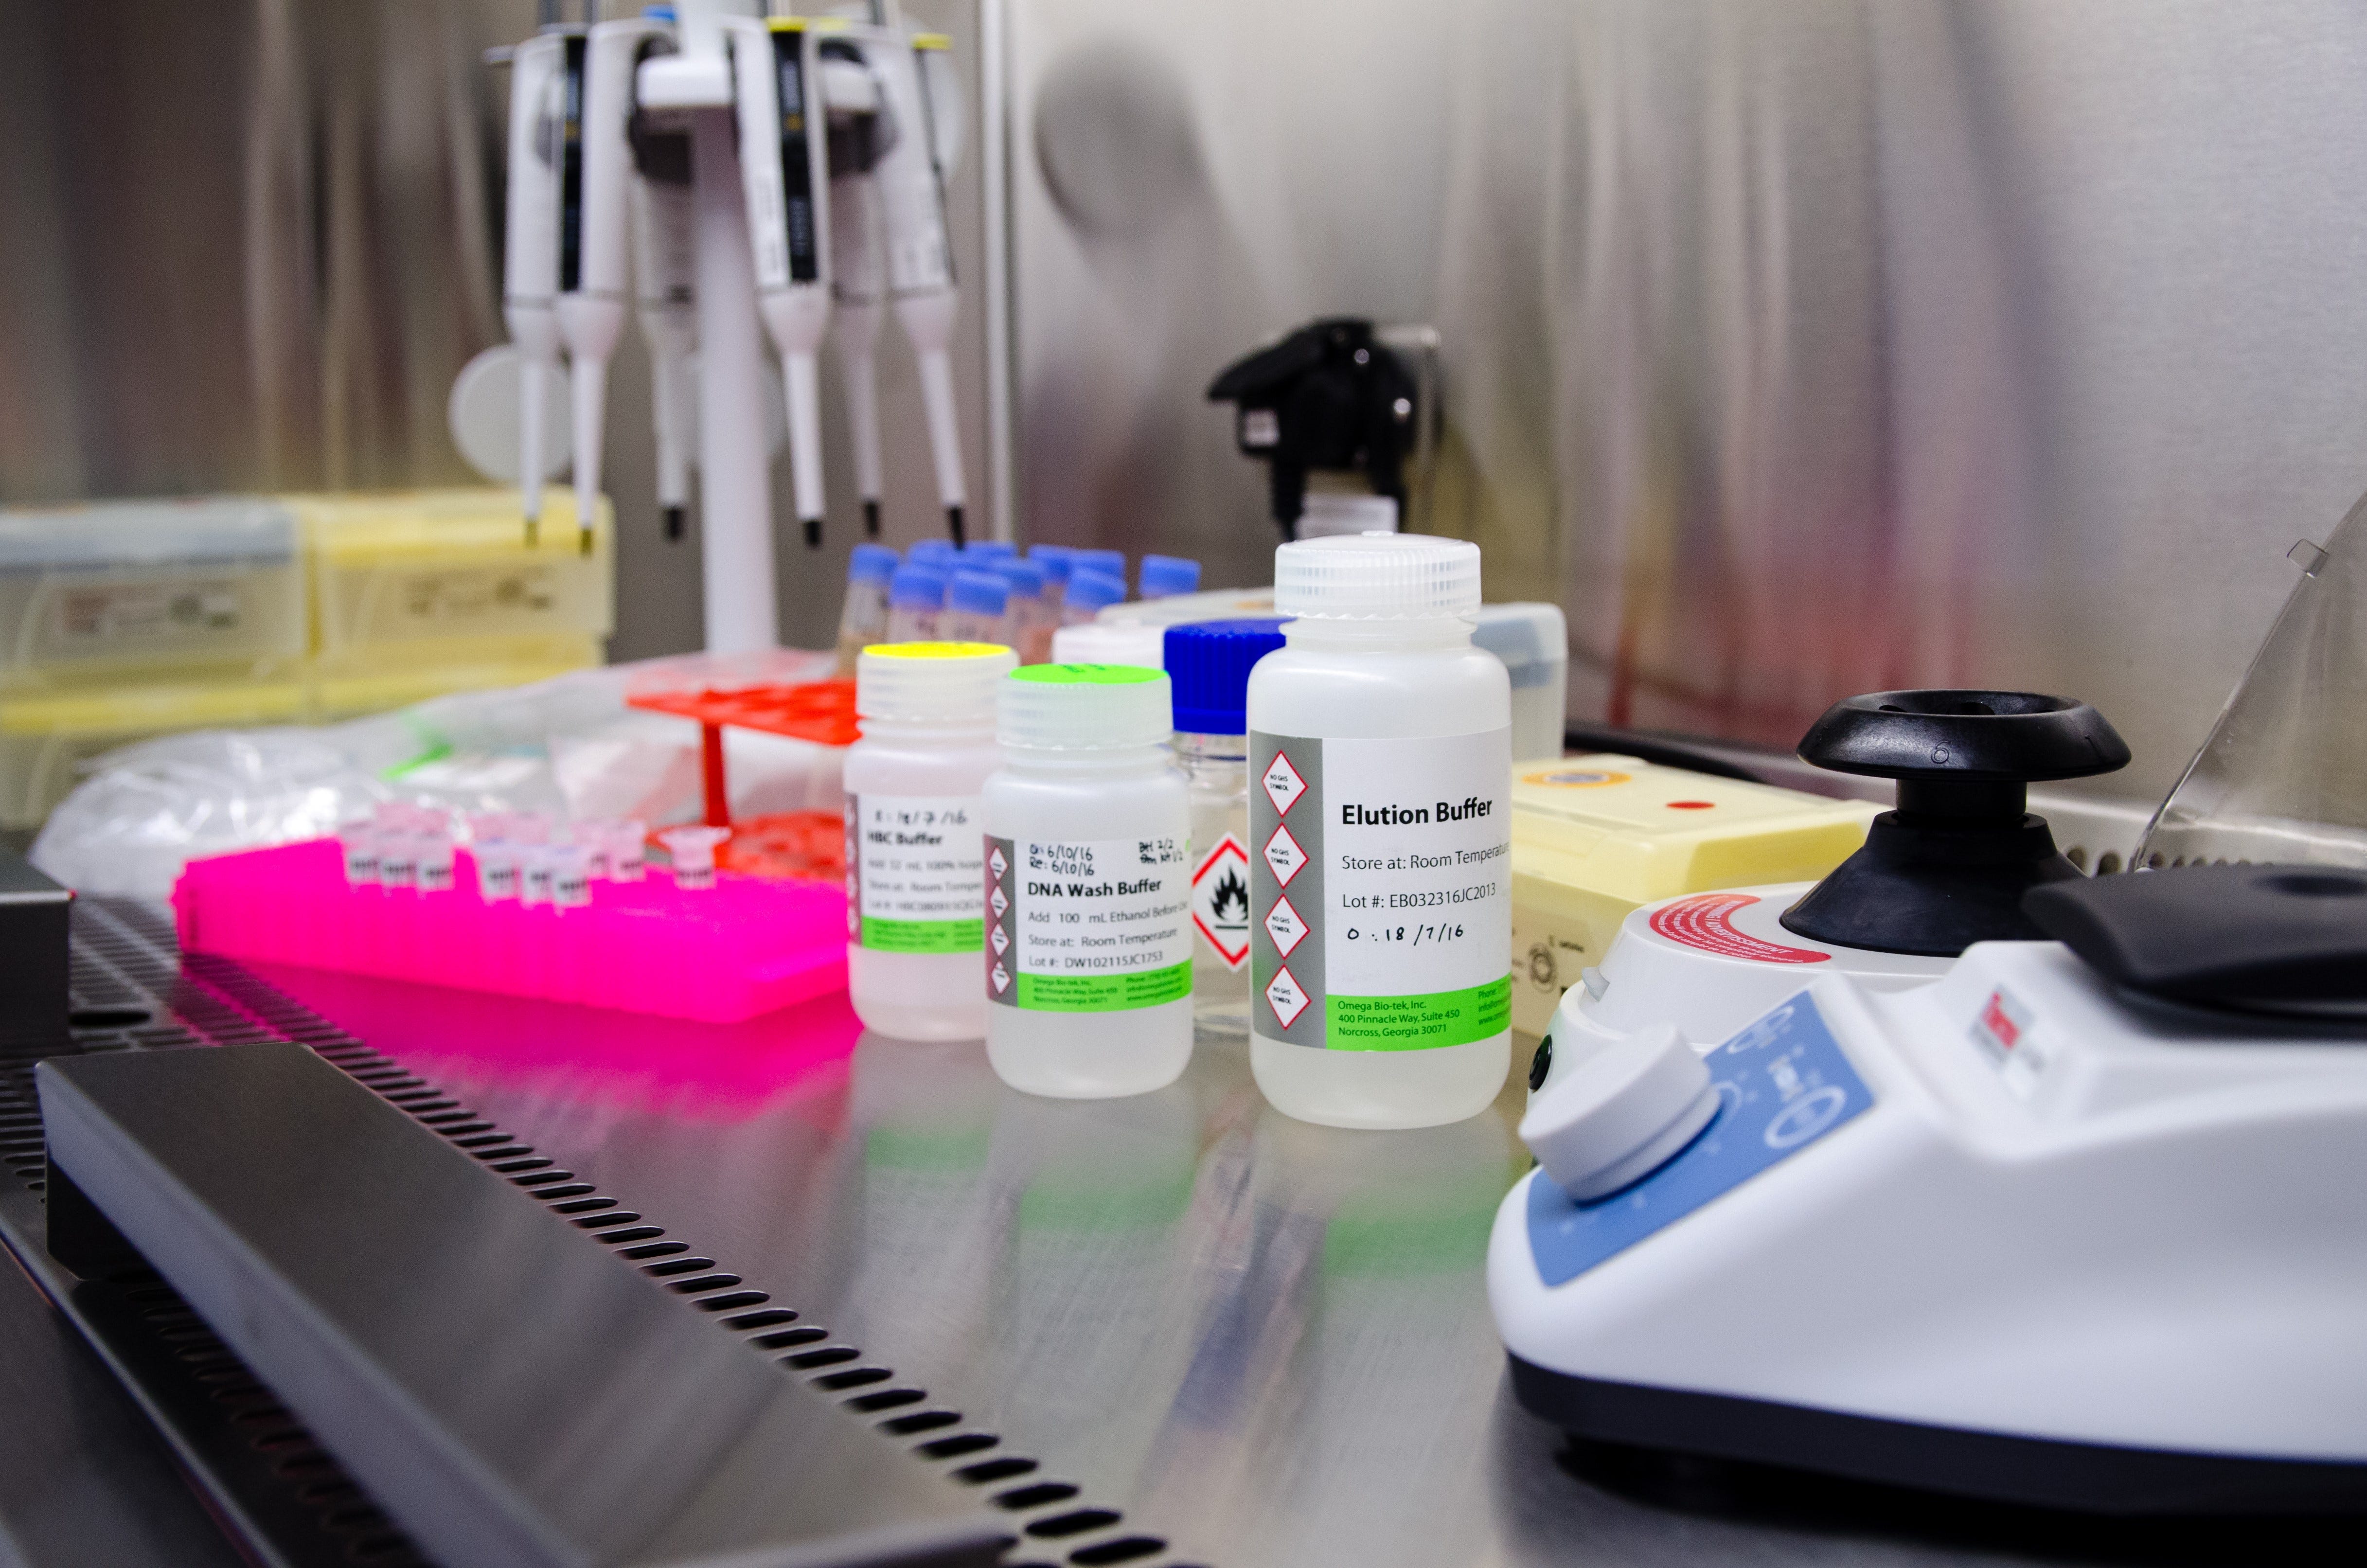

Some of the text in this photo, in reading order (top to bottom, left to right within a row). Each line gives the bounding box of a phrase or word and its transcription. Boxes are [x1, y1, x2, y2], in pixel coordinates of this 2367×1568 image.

[1342, 797, 1492, 825] Elution Buffer
[896, 831, 942, 845] Buffer
[1271, 856, 1290, 865] SYMBOL
[1342, 855, 1382, 869] Store
[1388, 857, 1406, 869] at:
[1411, 855, 1452, 868] Room
[1028, 878, 1161, 897] DNA Wash Buffer
[1343, 882, 1495, 908] Lot #: EB032316JC2013
[1028, 912, 1050, 923] Add
[1060, 913, 1080, 923] 100
[1089, 913, 1106, 924] mL
[1110, 908, 1151, 923] Ethanol
[1153, 904, 1177, 918] Before
[1029, 927, 1177, 947] Store at: Room Temperature
[1029, 955, 1046, 967] Lot
[1338, 1000, 1426, 1012] Omega Bio-tek, Inc.
[1338, 1009, 1459, 1024] 400 Pinnacle Way, Suite 450
[1338, 1024, 1446, 1037] Norcross, Georgia 30071
